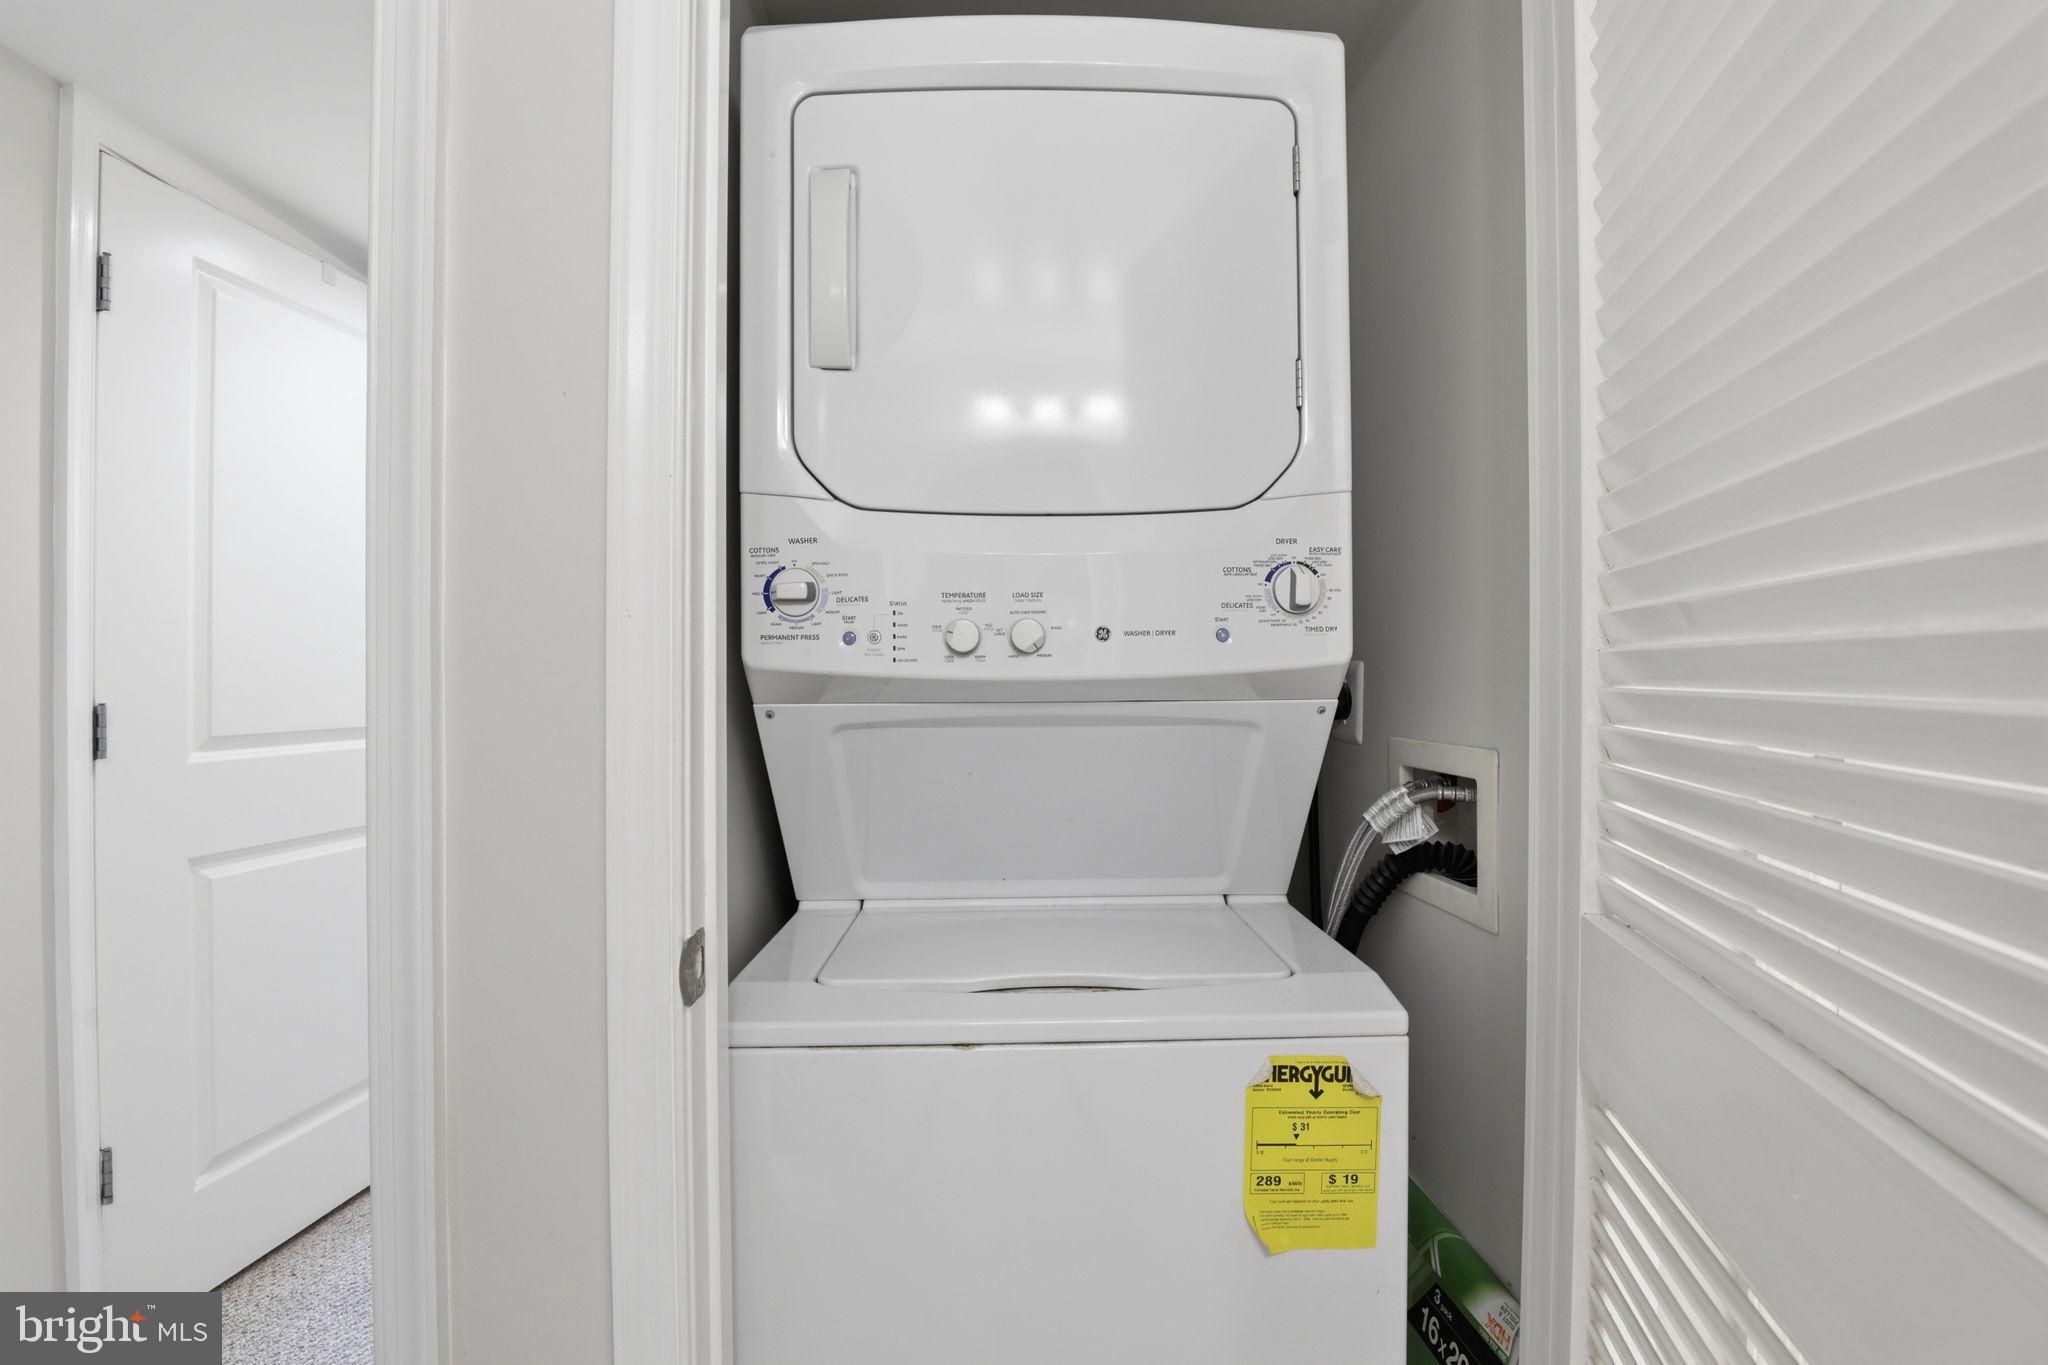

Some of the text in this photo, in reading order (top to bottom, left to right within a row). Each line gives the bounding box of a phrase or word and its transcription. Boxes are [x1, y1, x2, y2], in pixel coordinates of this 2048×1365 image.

[788, 537, 818, 545] WASHER
[1292, 1122, 1310, 1131] $ 31
[1256, 1175, 1281, 1187] 289
[1329, 1174, 1359, 1185] $ 19
[1434, 1288, 1441, 1305] 3
